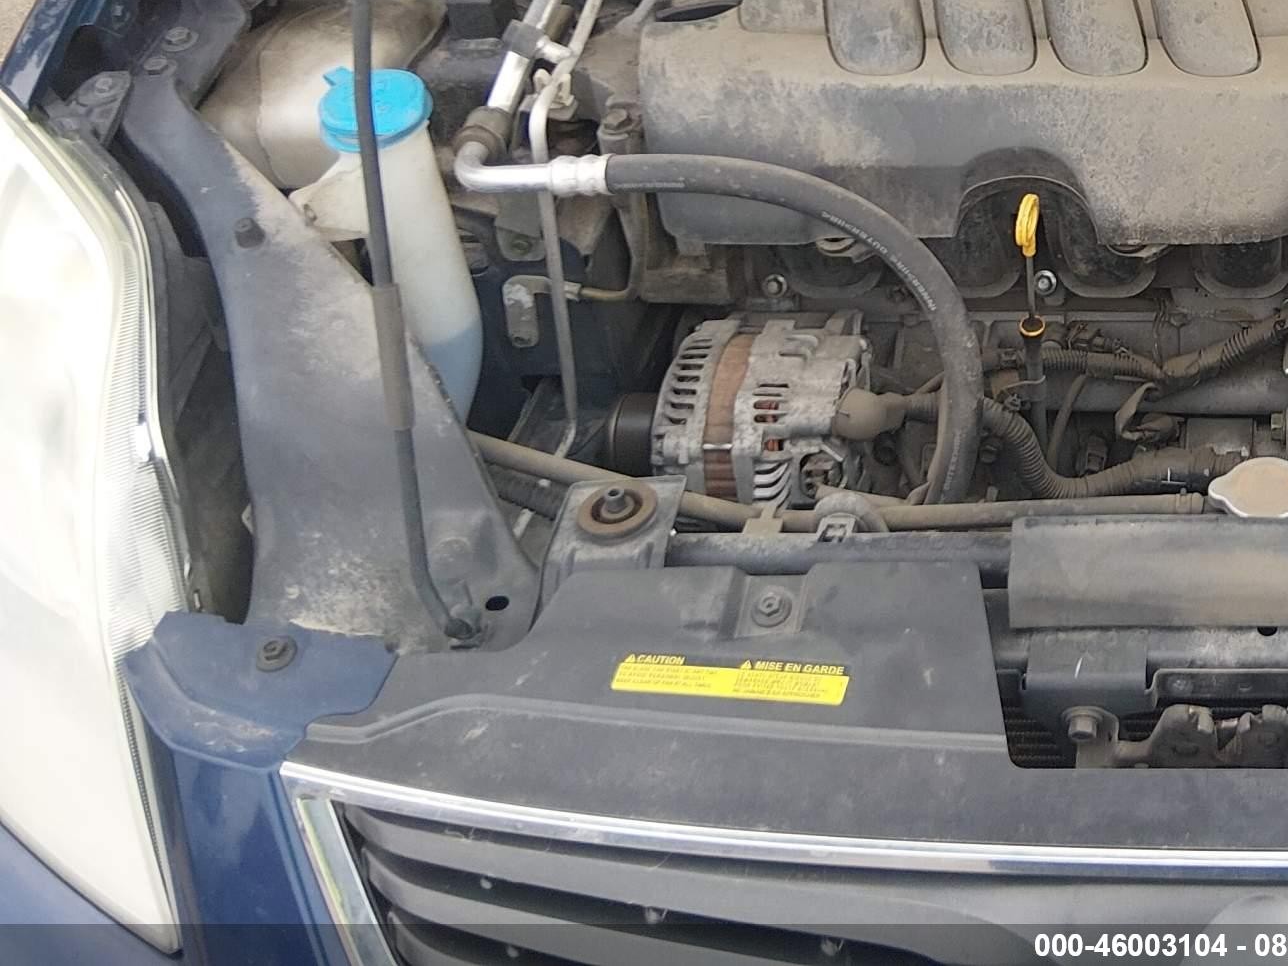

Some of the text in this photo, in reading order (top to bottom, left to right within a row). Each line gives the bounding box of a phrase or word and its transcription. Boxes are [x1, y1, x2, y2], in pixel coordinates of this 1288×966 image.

[637, 654, 685, 665] CAUTION
[755, 660, 845, 675] MISE EN GARDE
